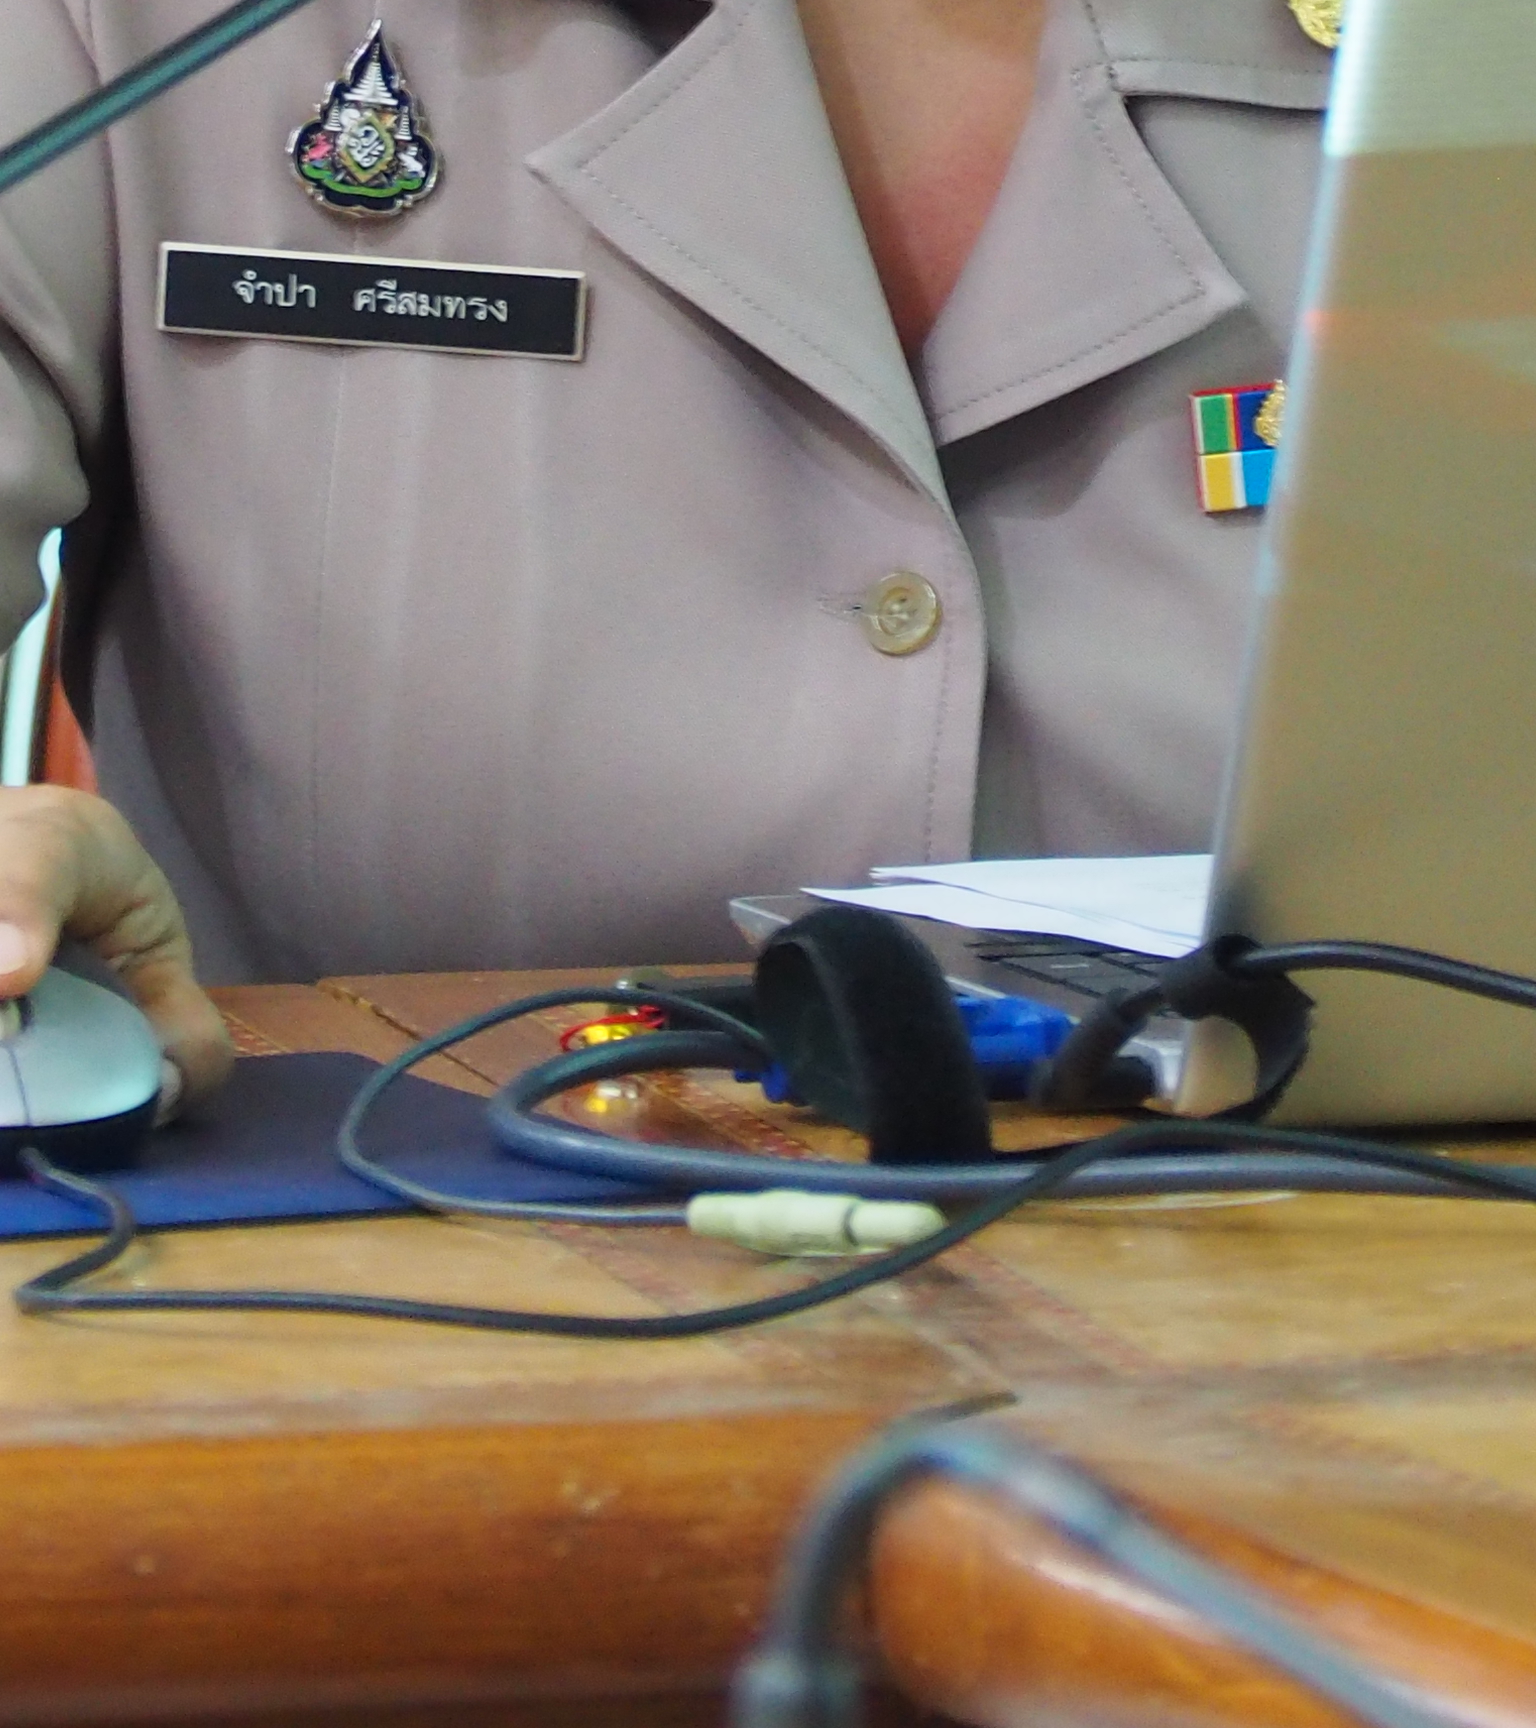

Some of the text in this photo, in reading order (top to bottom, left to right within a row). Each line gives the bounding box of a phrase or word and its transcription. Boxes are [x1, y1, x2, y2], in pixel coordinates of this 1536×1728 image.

[231, 269, 509, 323] จำปา ศรีสมทรง
